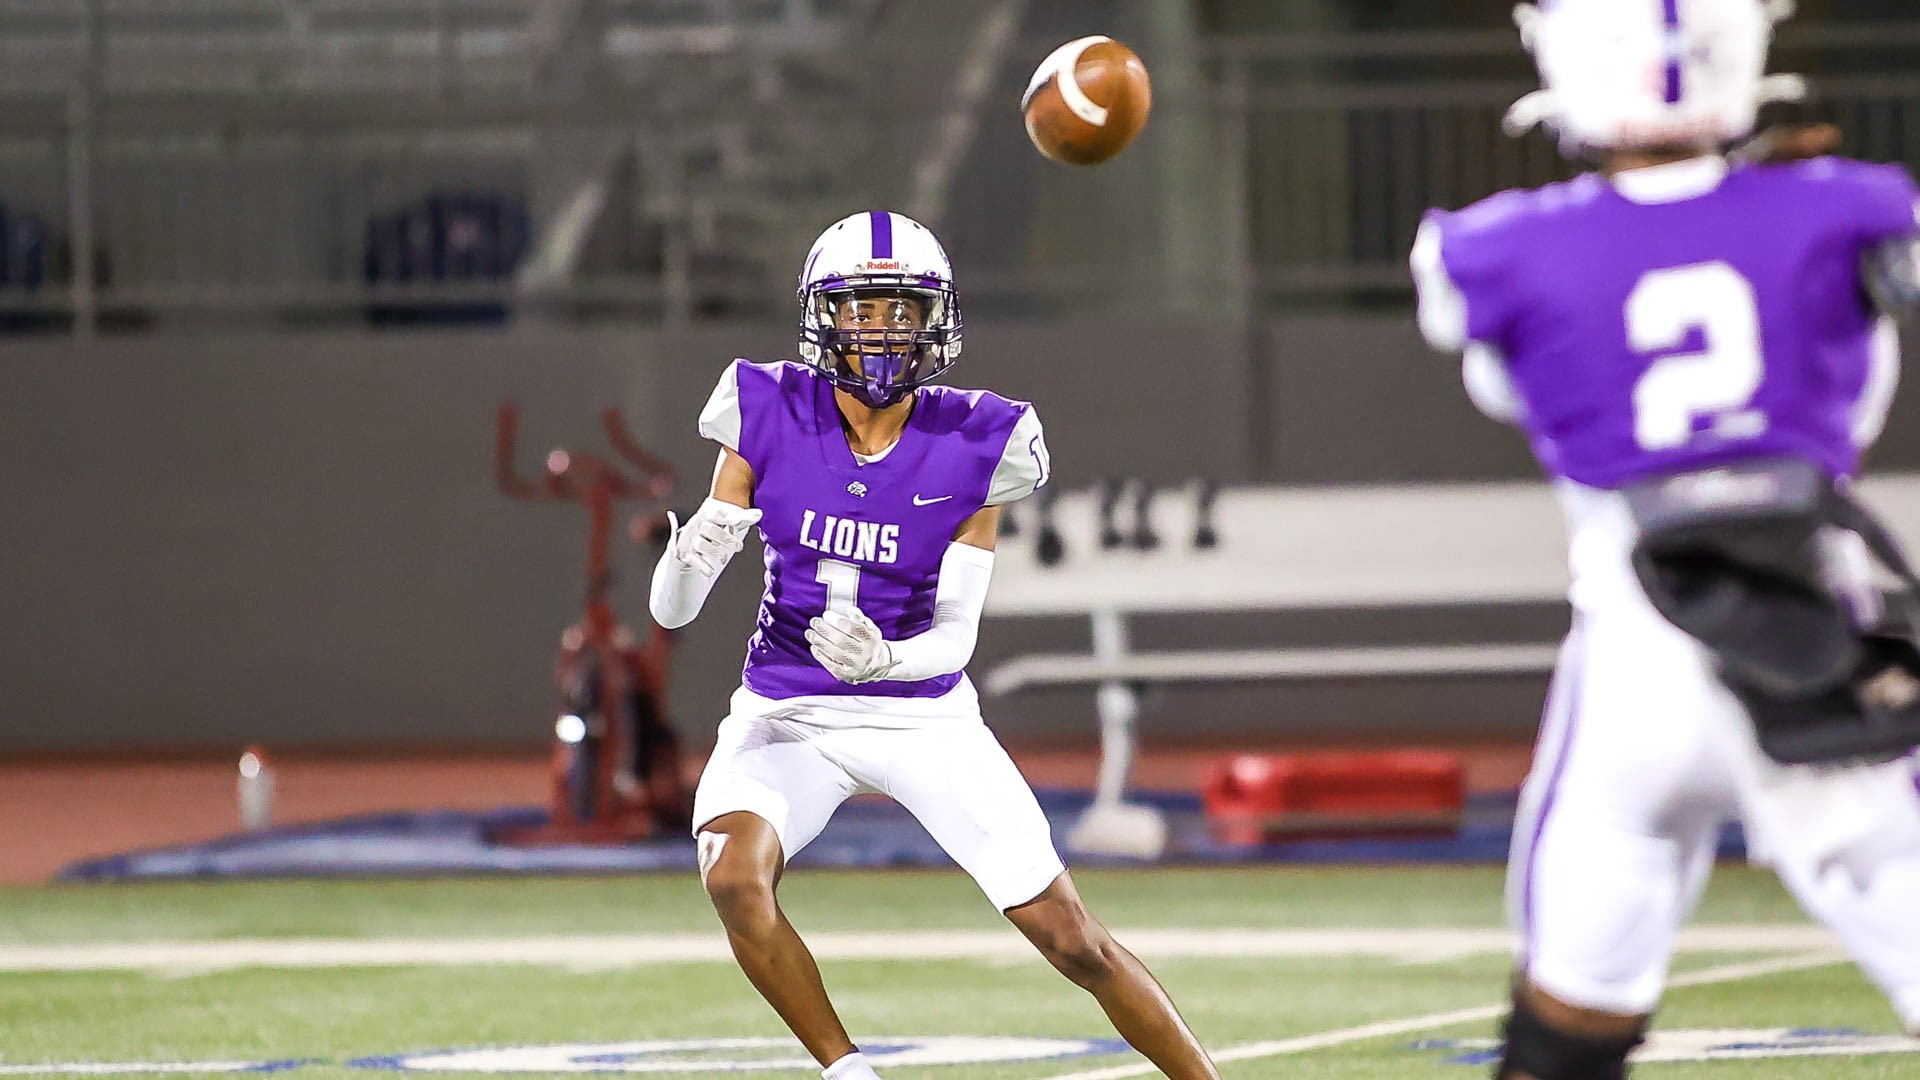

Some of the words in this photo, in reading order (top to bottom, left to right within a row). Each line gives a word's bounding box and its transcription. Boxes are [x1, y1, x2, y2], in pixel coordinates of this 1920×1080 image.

[867, 261, 900, 270] Riddell
[1624, 261, 1768, 451] 2
[799, 509, 900, 564] LIONS
[814, 558, 862, 616] 1
